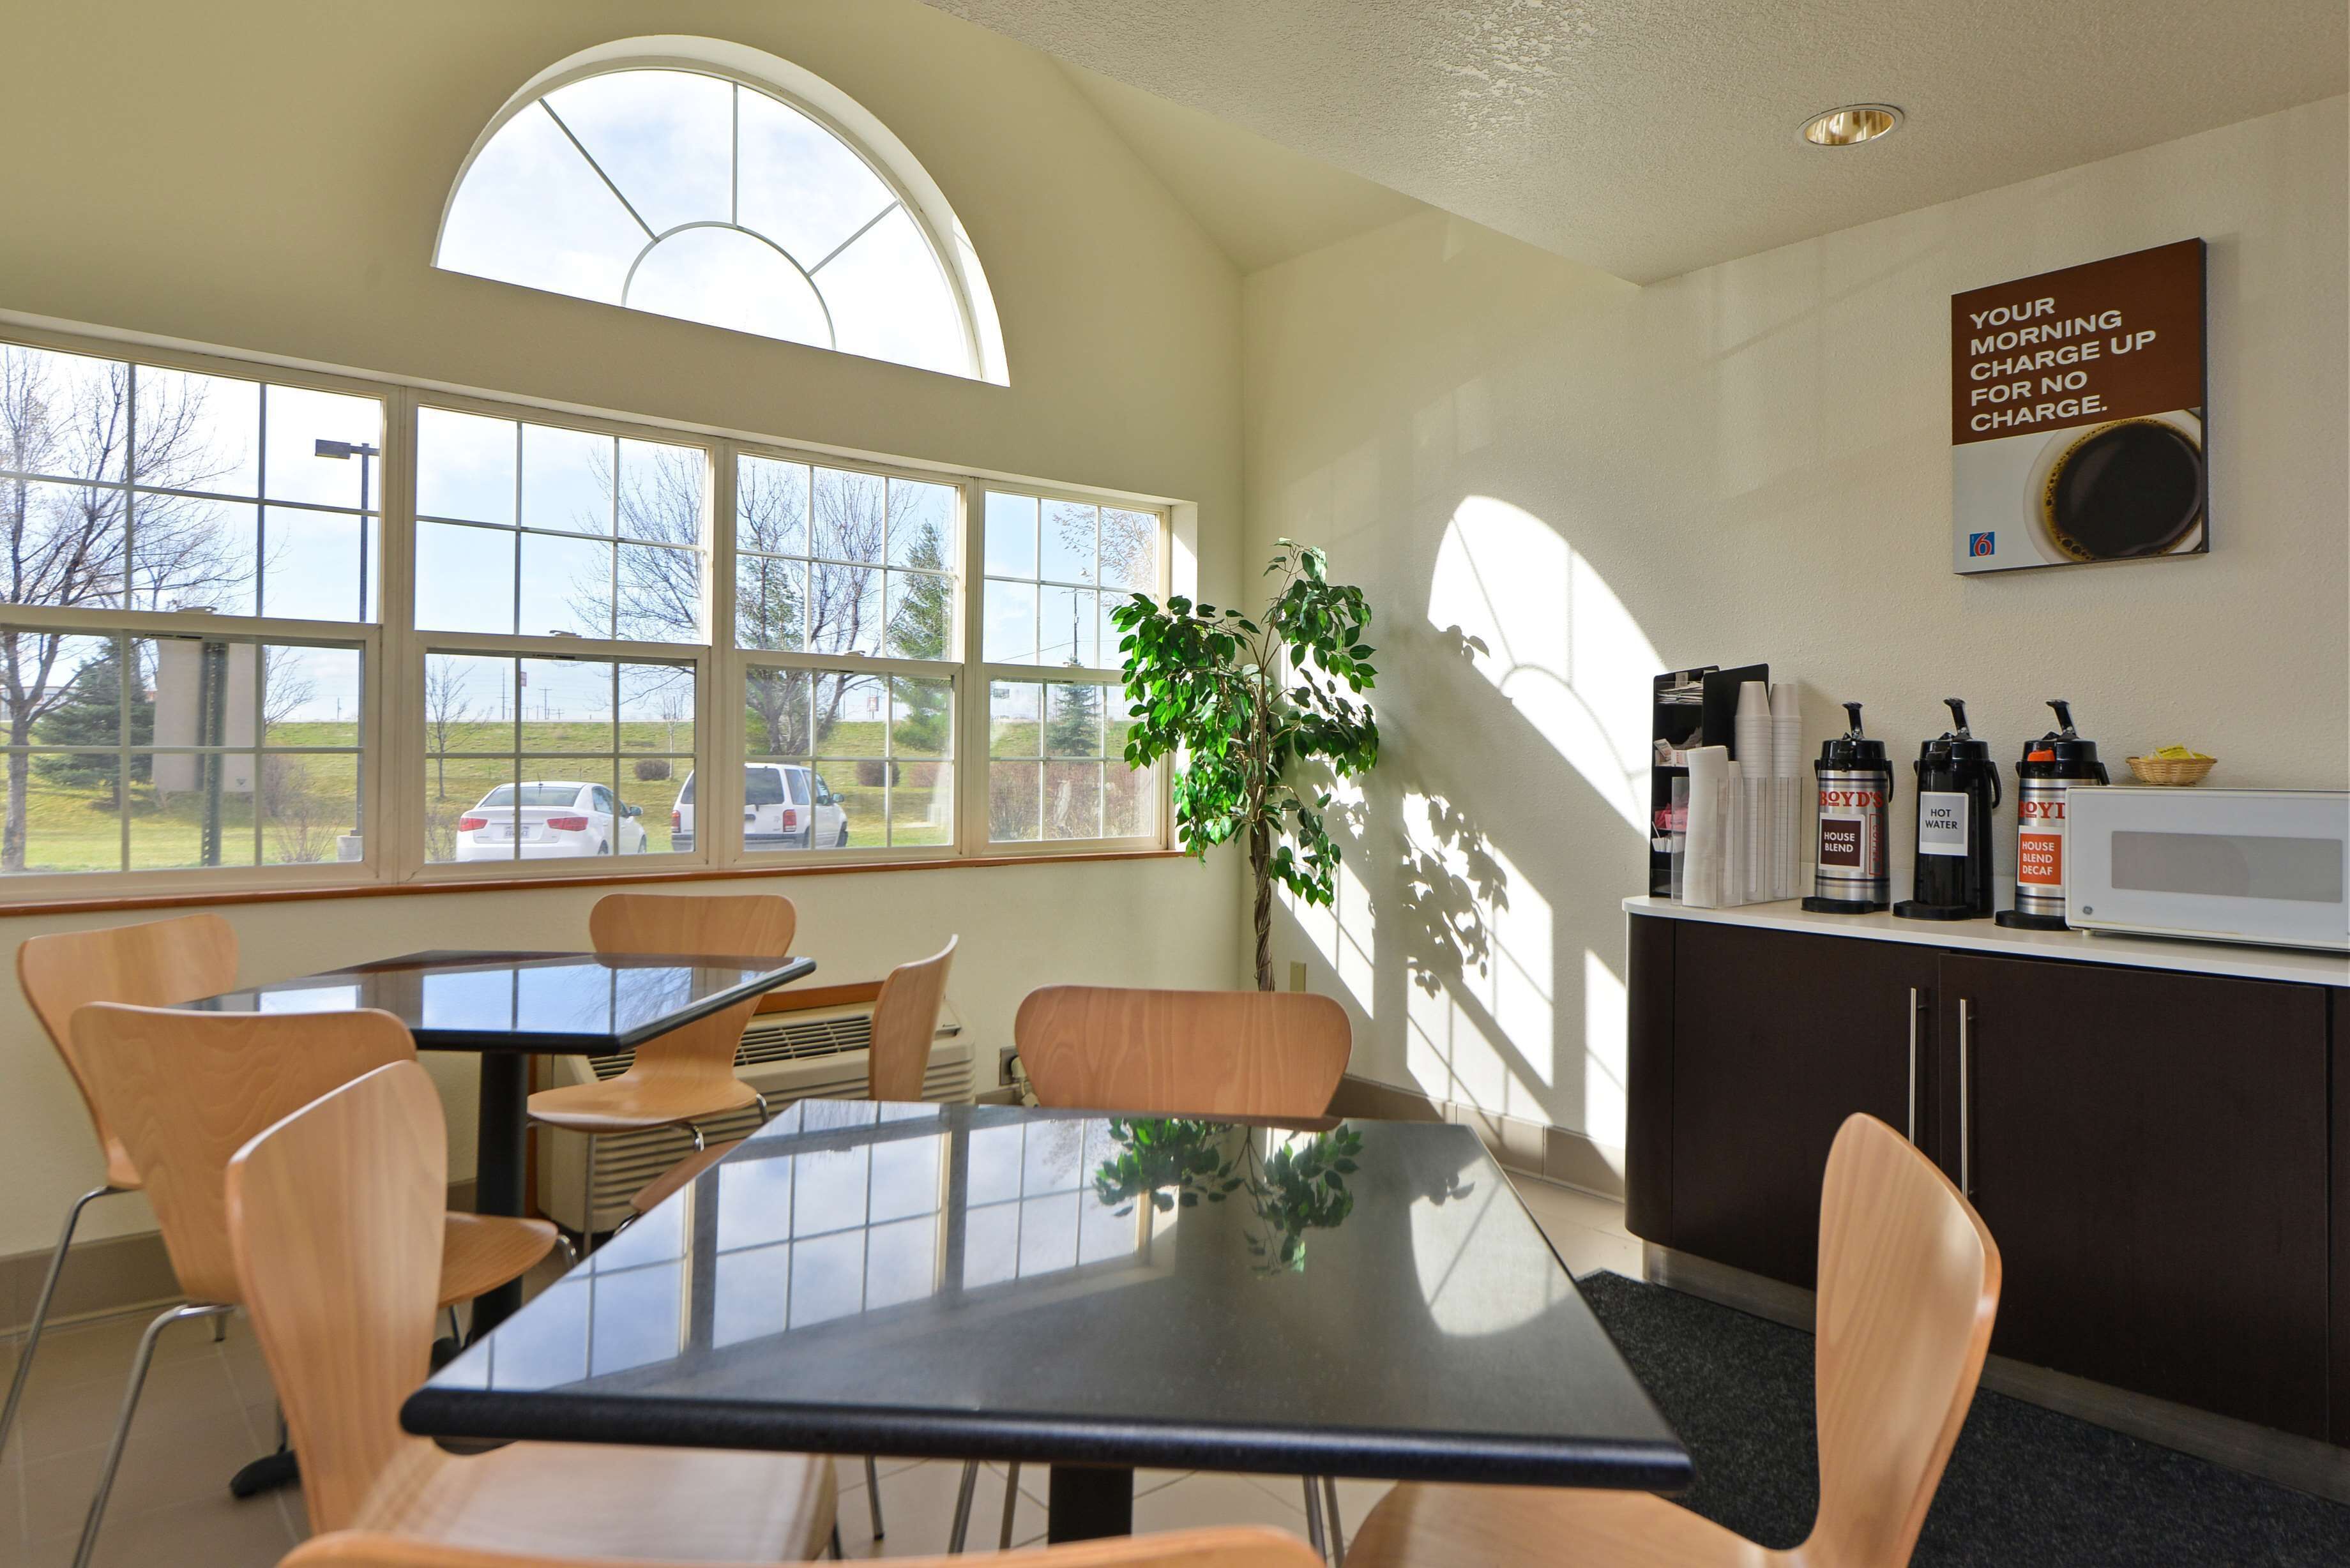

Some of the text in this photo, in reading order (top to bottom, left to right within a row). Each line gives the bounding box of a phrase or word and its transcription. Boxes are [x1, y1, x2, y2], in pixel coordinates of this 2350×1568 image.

[1969, 298, 2055, 329] YOUR
[1971, 310, 2122, 356] MORNING
[1970, 330, 2156, 381] CHARGE UP
[1971, 371, 2088, 407] FOR NO
[1971, 395, 2107, 432] CHARGE.
[1974, 532, 1992, 557] 6
[1819, 790, 1883, 808] BOYD'S
[1930, 808, 1952, 817] HOT
[1925, 820, 1958, 829] WATER
[1824, 831, 1855, 841] HOUSE
[1824, 843, 1854, 852] BLEND
[2022, 841, 2054, 852] HOUSE
[2022, 853, 2053, 863] BLEND
[2022, 865, 2053, 876] DECAF
